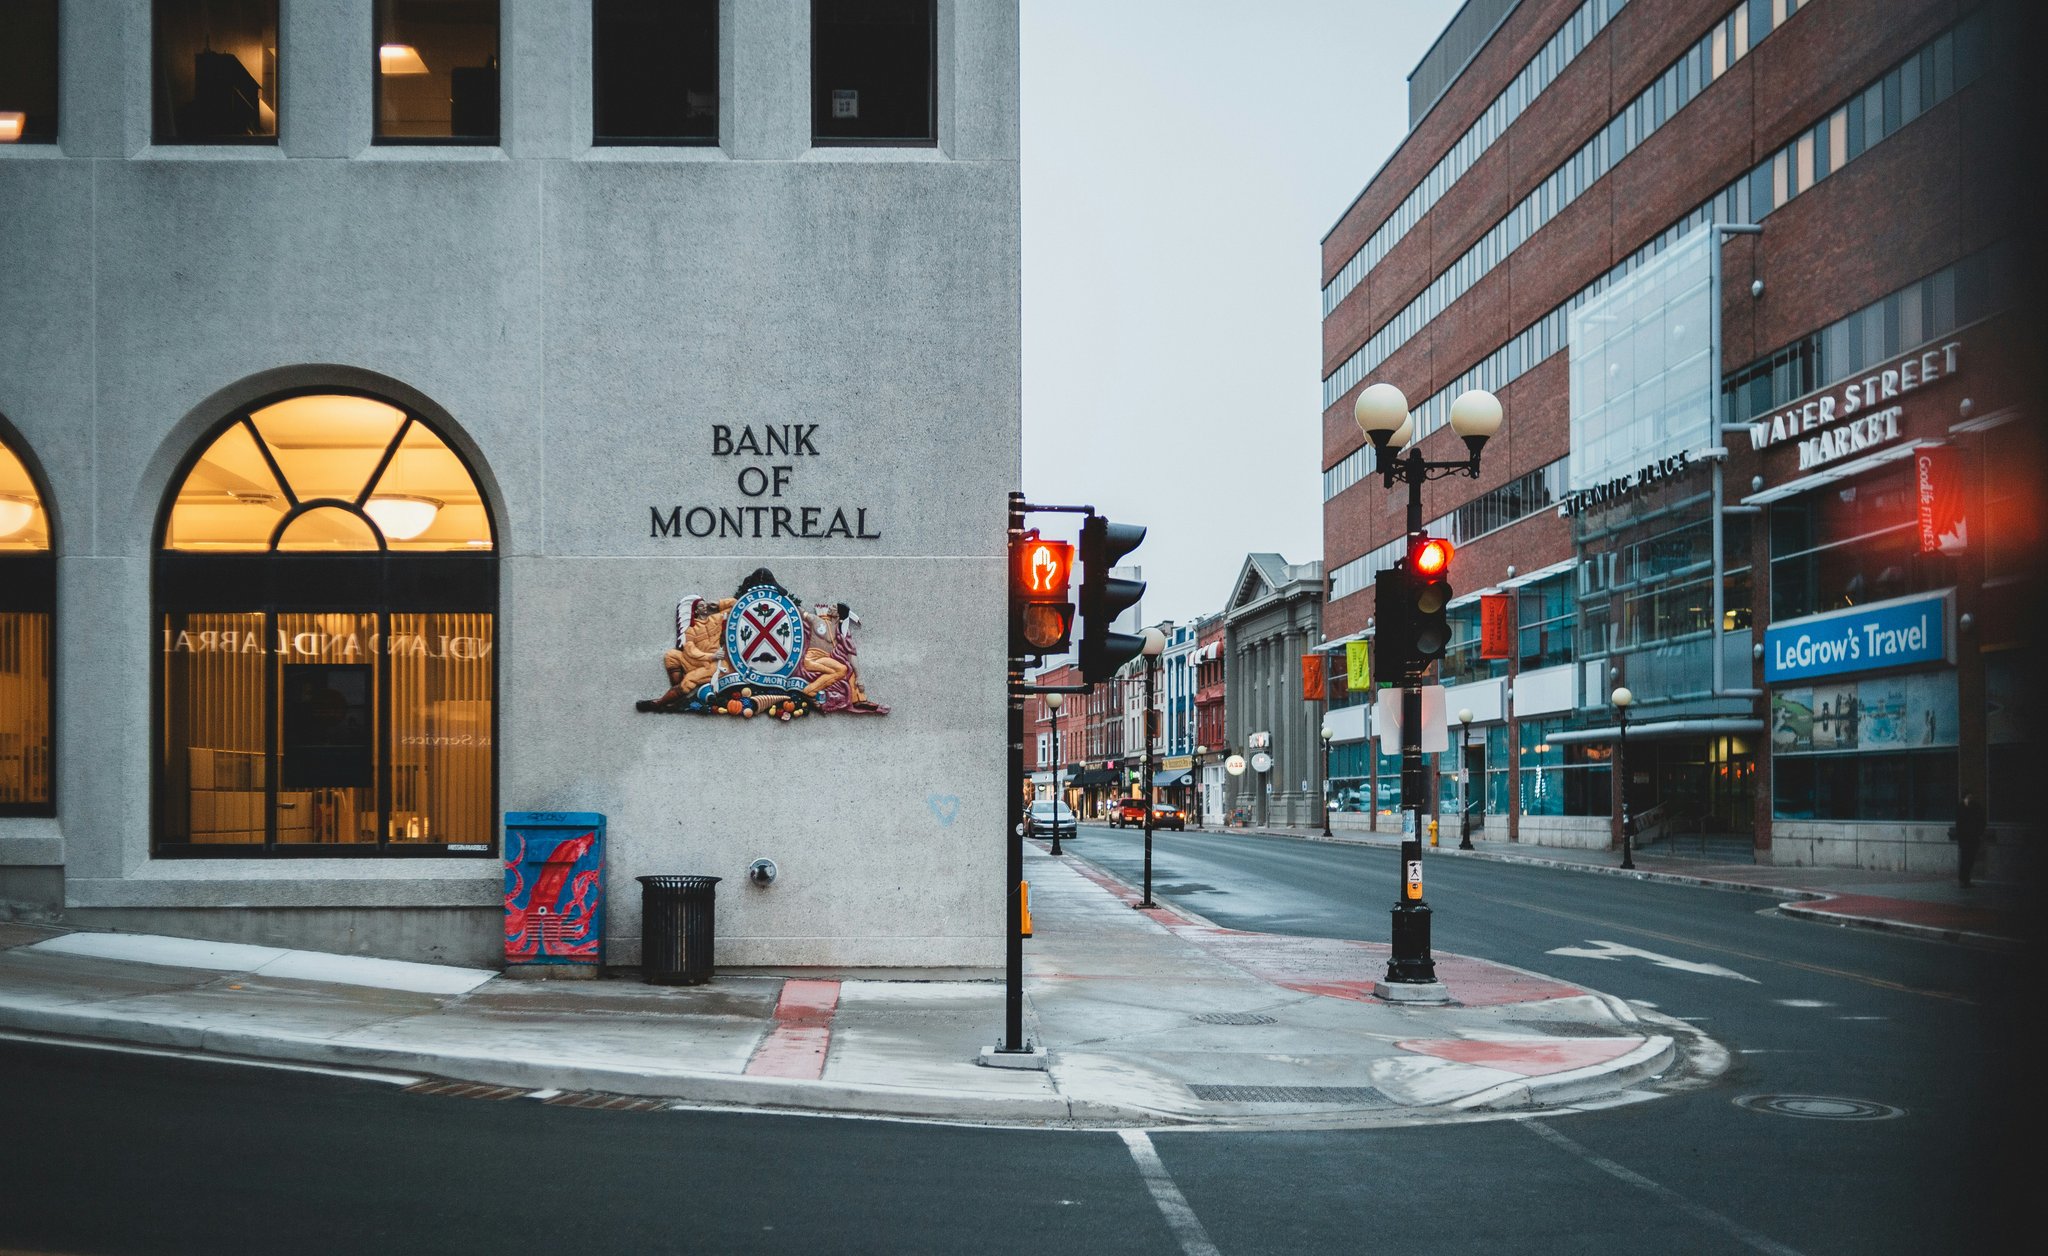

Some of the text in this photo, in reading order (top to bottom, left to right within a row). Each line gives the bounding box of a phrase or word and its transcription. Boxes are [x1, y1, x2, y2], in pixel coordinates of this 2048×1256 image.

[1750, 342, 1961, 450] WATER STREET
[711, 424, 820, 456] BANK
[1798, 406, 1903, 471] MARKET
[737, 465, 793, 497] OF
[1557, 449, 1689, 519] ATLANTIC PLACE
[650, 505, 881, 539] MONTREAL
[1921, 506, 1935, 553] FITNESS
[728, 591, 801, 653] CONCORDIA SALUS
[1776, 614, 1927, 671] LeGrow's Travel
[720, 672, 805, 689] BANK OF MONTREAL
